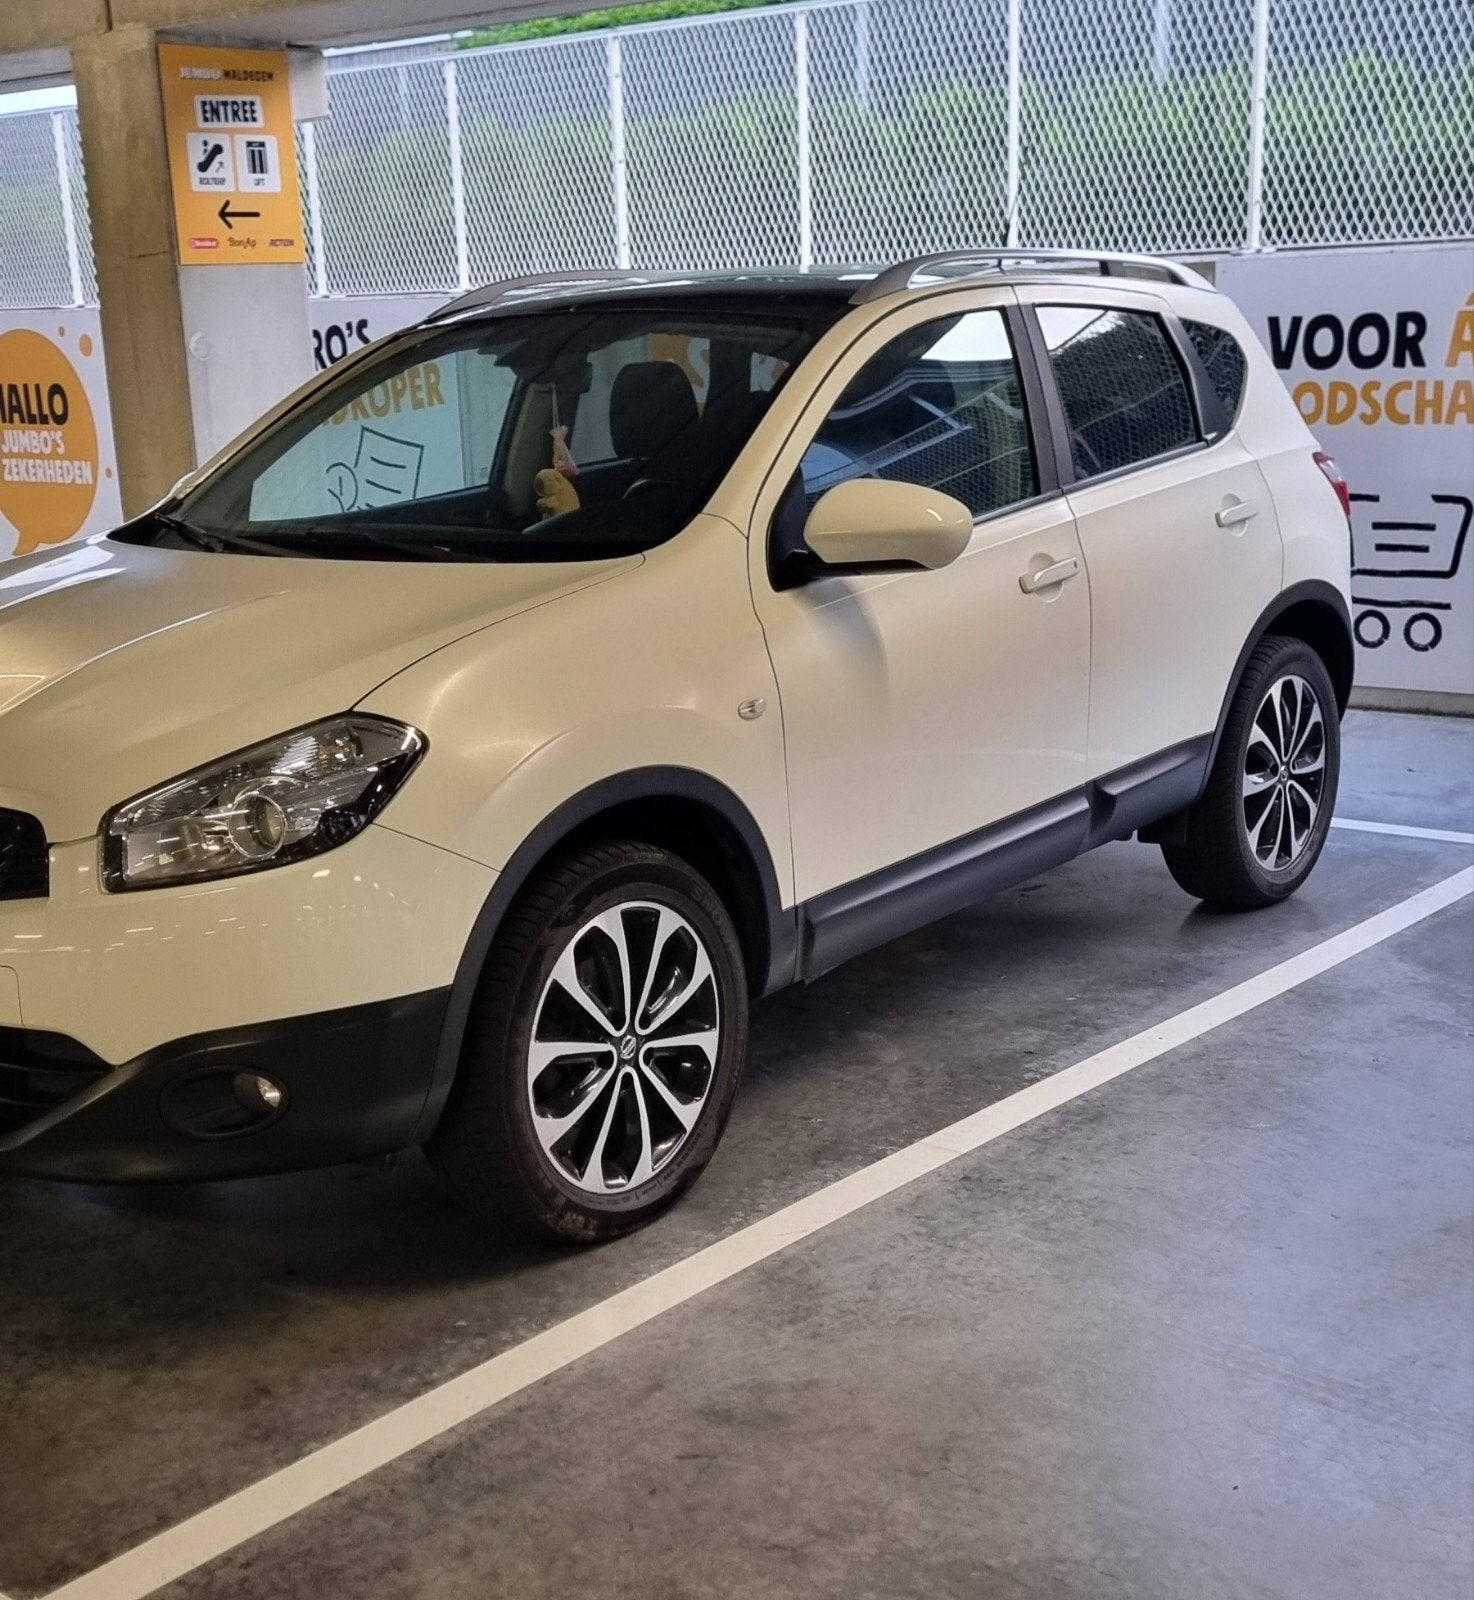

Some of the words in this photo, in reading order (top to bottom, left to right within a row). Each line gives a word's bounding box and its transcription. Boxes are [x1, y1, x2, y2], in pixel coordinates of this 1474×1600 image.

[201, 100, 258, 122] ENTREE
[1267, 311, 1427, 370] VOOR
[2, 430, 65, 455] JUMBO'S
[2, 458, 93, 485] ZEKERHEDEN
